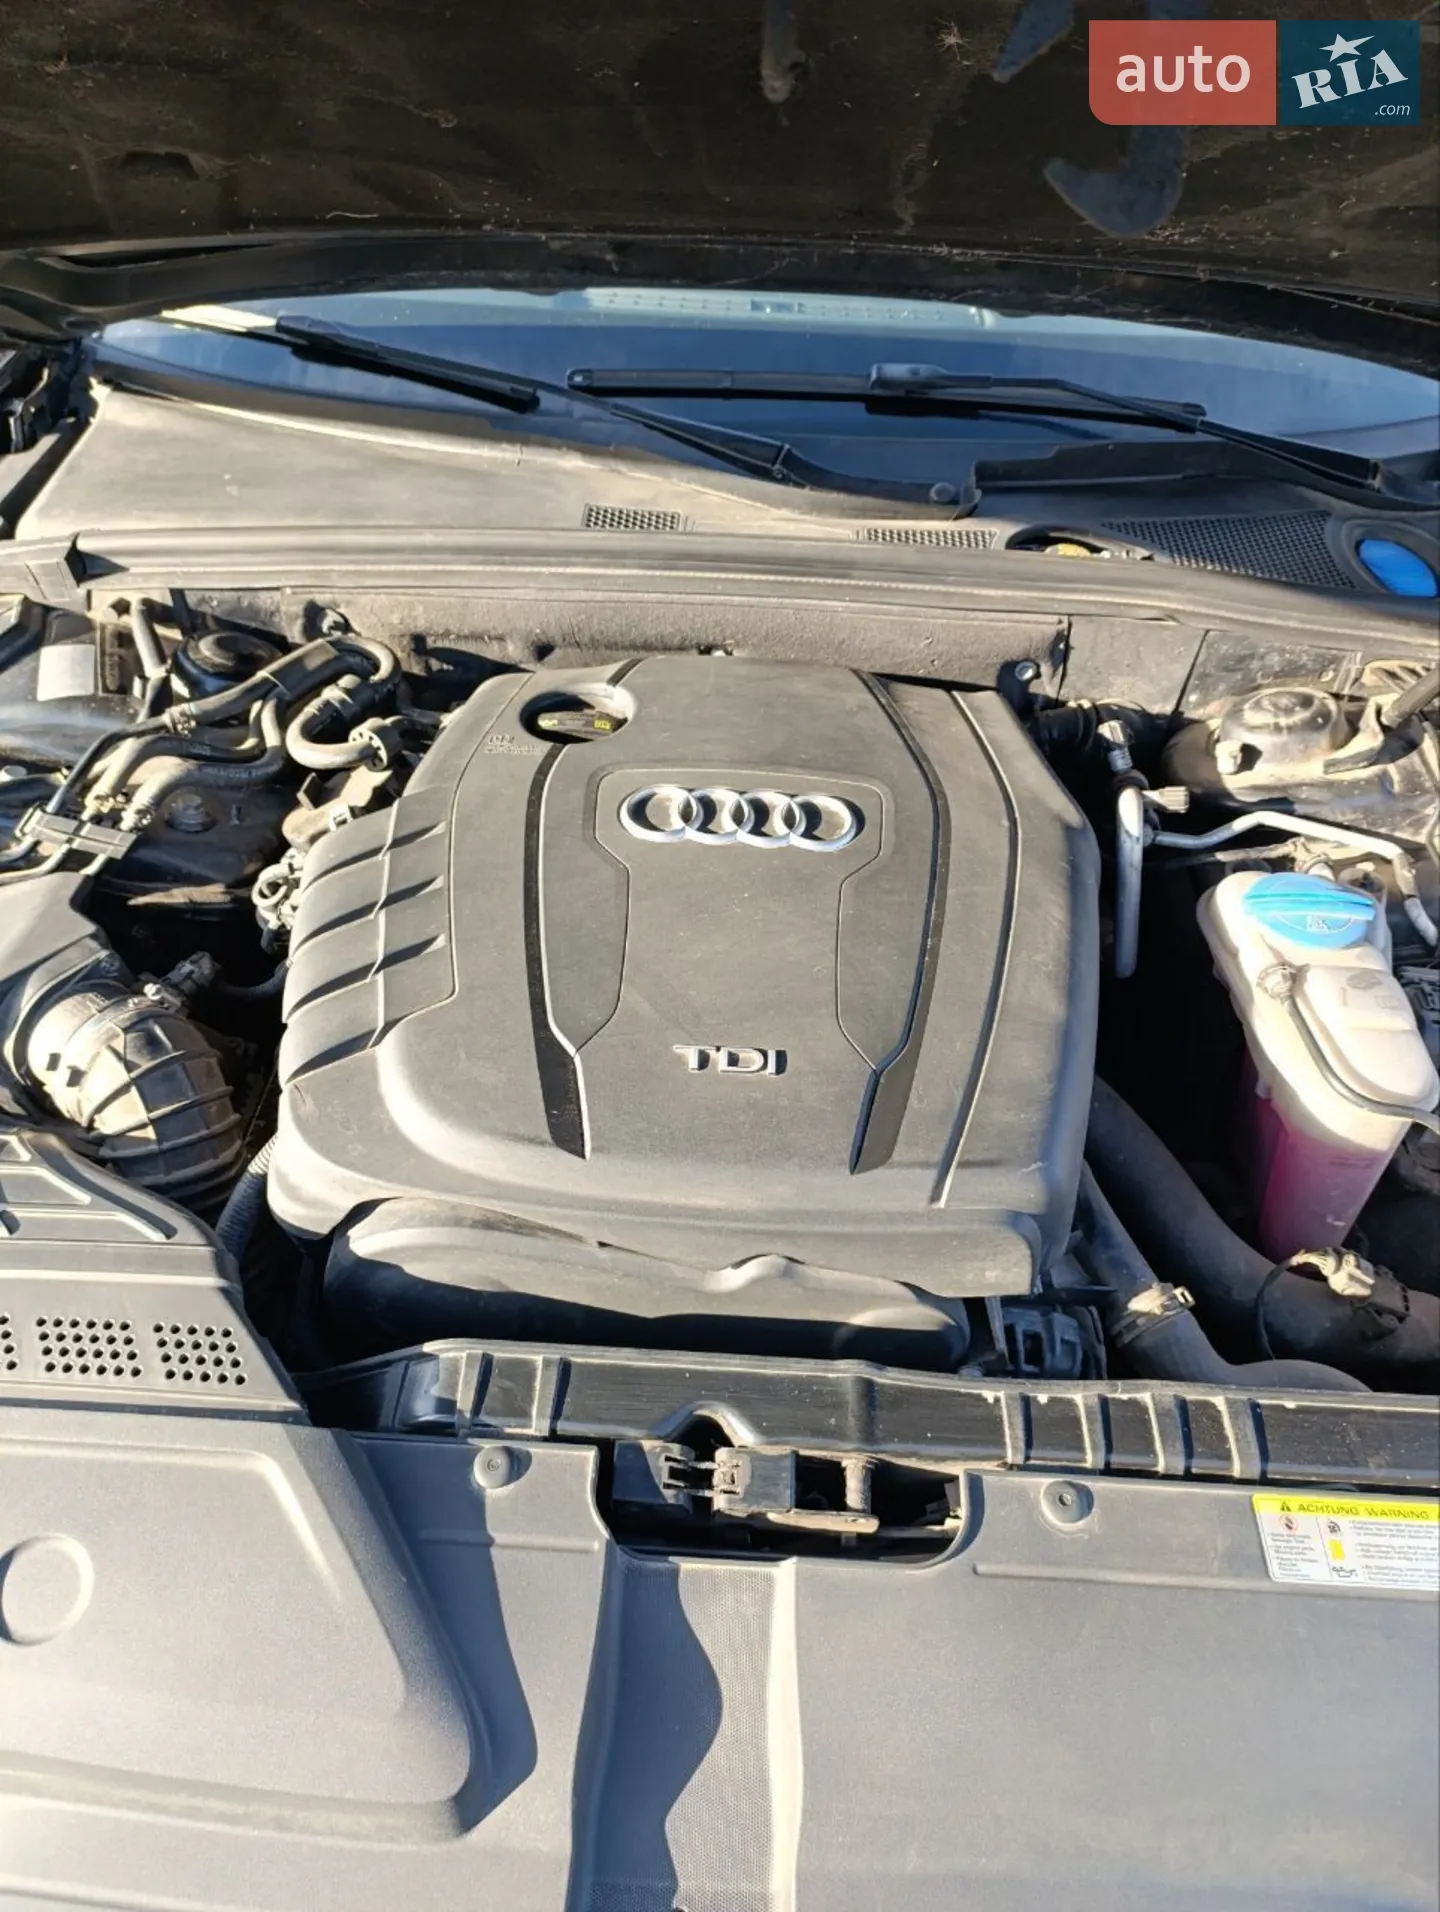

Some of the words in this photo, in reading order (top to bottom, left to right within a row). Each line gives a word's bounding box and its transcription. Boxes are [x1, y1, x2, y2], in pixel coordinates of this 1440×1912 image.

[673, 1044, 787, 1076] TDI
[1297, 1503, 1360, 1516] ACHTUNG
[1365, 1507, 1430, 1520] WARNING
